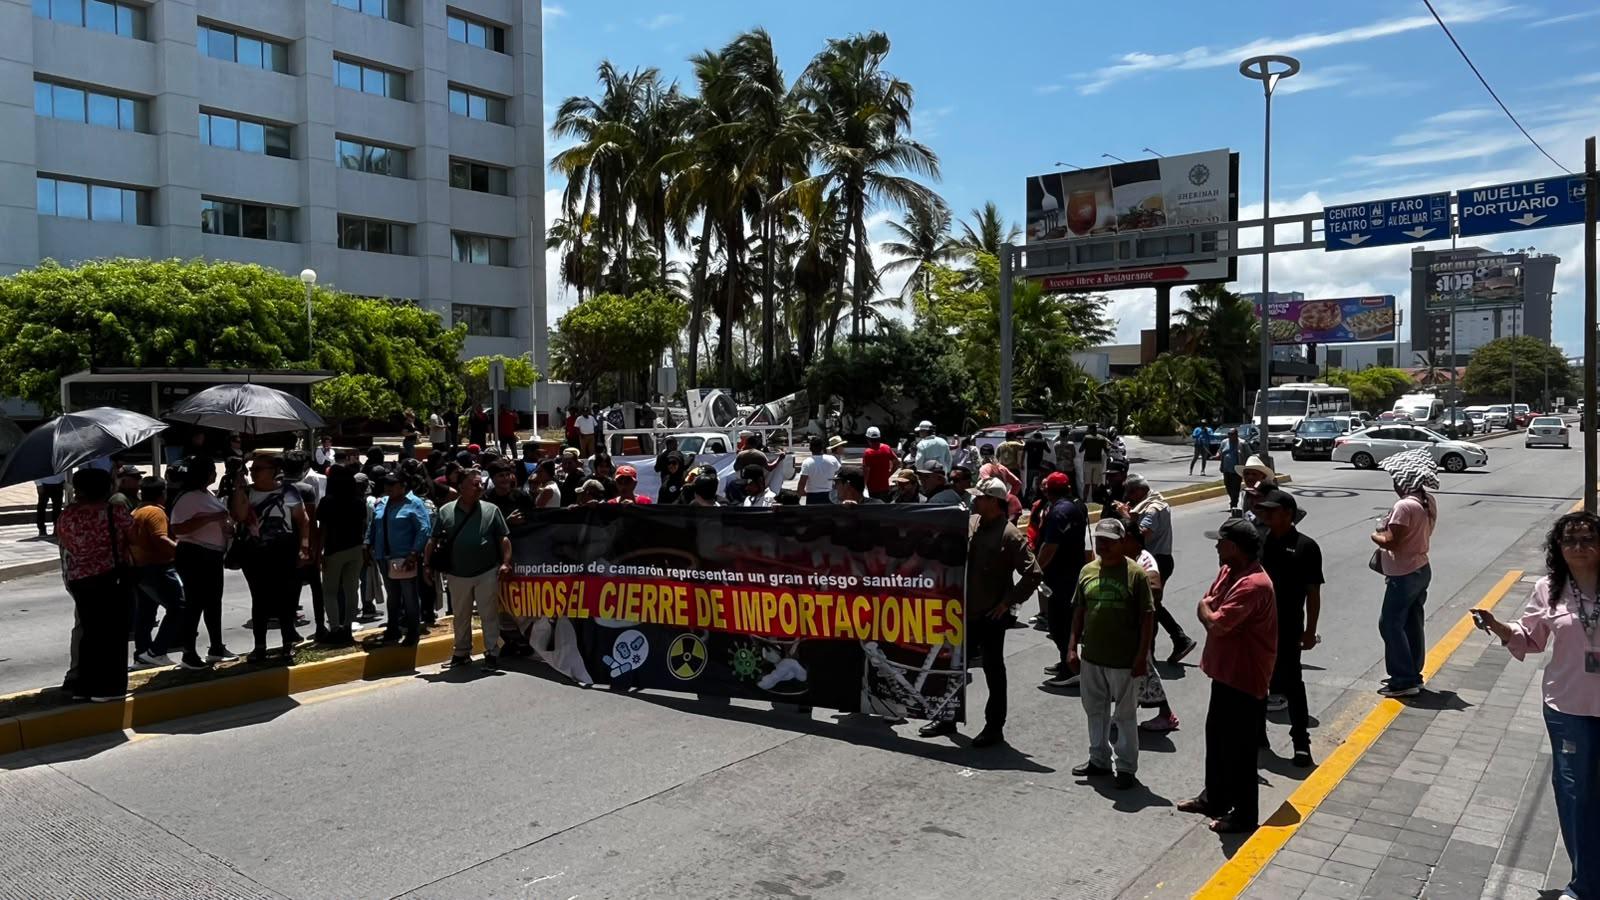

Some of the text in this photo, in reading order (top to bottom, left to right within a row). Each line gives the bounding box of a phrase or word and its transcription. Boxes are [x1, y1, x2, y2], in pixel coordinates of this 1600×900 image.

[1473, 182, 1545, 203] MUELLE
[1329, 206, 1366, 220] CENTRO
[1391, 199, 1424, 212] FARO
[1463, 195, 1559, 218] PORTUARIO
[1329, 219, 1367, 232] TEATRO
[1397, 214, 1411, 225] DEL
[1412, 211, 1428, 223] MAR
[1076, 277, 1095, 286] libre
[1104, 271, 1154, 284] Restaurante
[588, 561, 605, 573] de
[609, 564, 664, 577] camarón
[666, 568, 744, 582] representan
[749, 572, 764, 583] un
[769, 573, 803, 586] gran
[807, 573, 858, 589] riesgo
[863, 573, 935, 589] sanitario
[598, 582, 689, 626] CIERRE
[694, 587, 727, 629] DE
[732, 590, 963, 646] IMPORTACIONES
